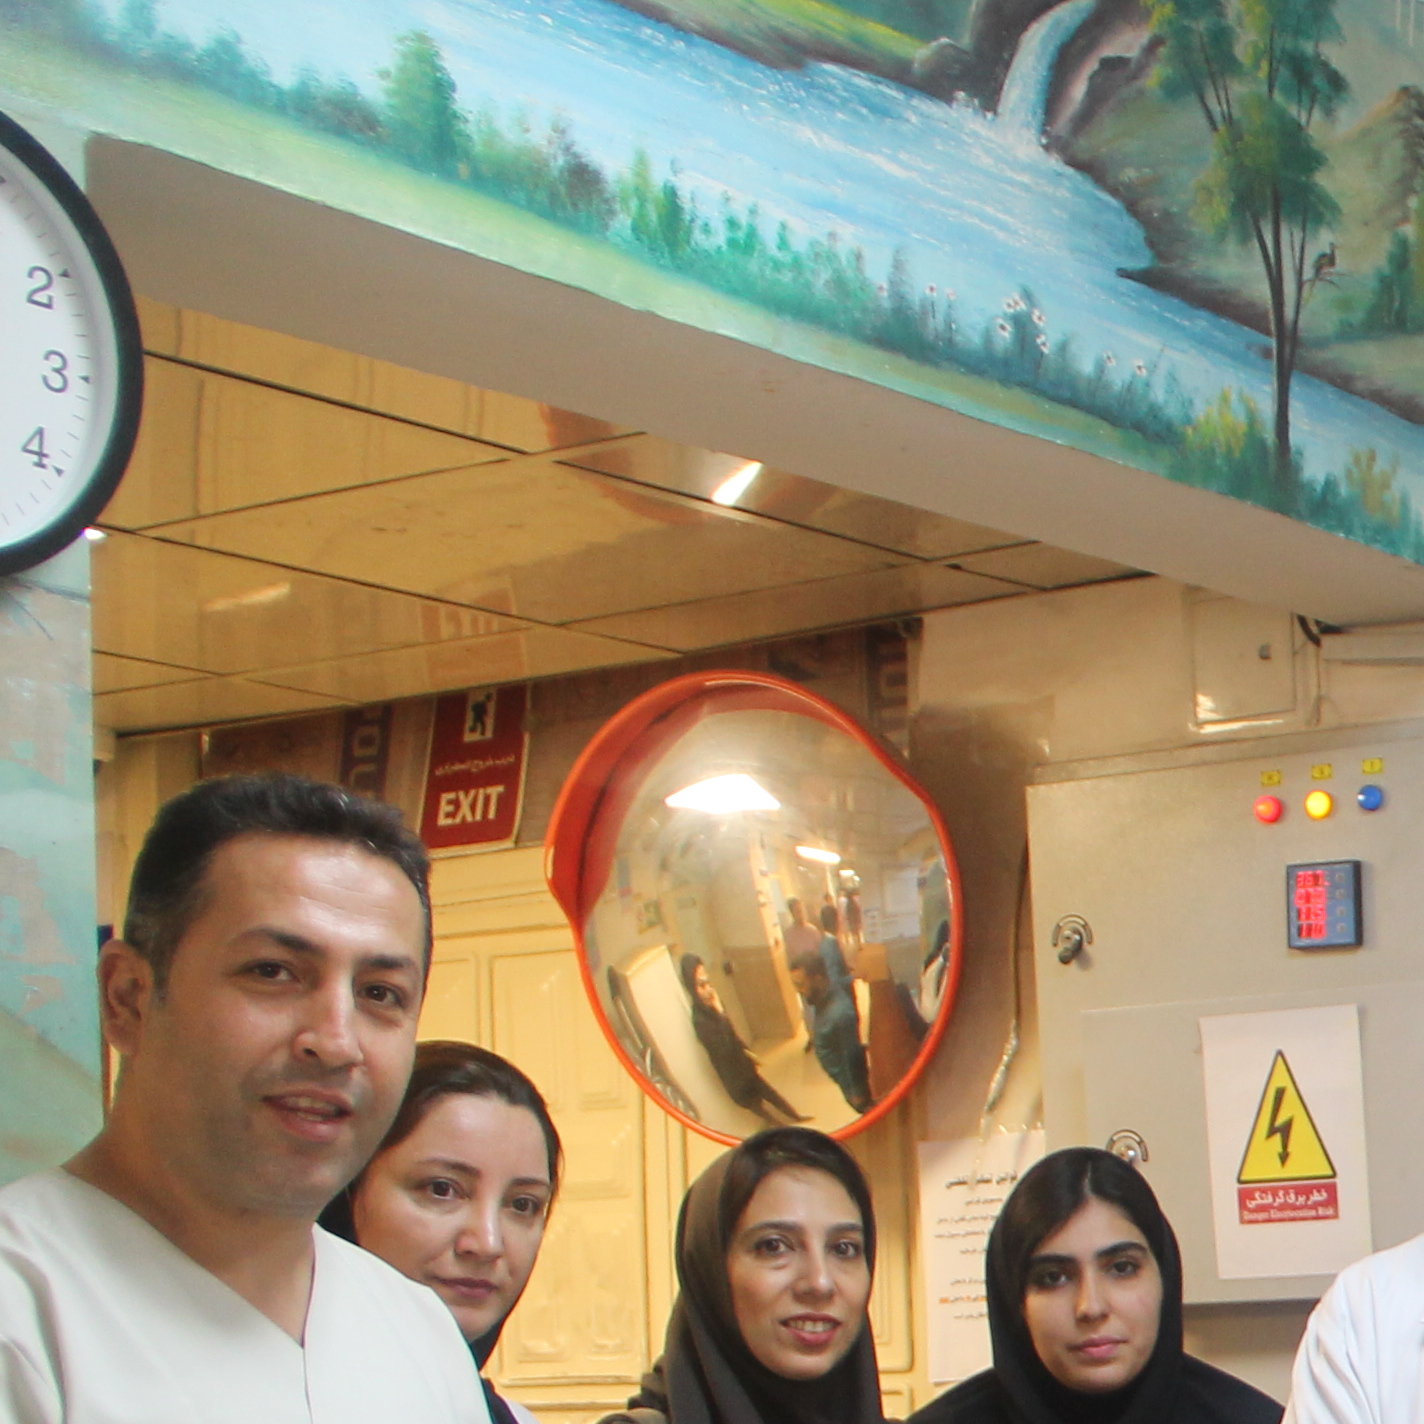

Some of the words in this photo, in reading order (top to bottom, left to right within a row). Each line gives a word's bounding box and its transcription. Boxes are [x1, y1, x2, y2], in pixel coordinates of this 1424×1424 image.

[26, 265, 54, 310] 2
[41, 349, 68, 393] 3
[20, 425, 50, 469] 4
[436, 784, 505, 827] EXIT
[1246, 1188, 1285, 1209] گرفتگی
[1286, 1188, 1306, 1206] برق
[1306, 1188, 1328, 1205] خطر
